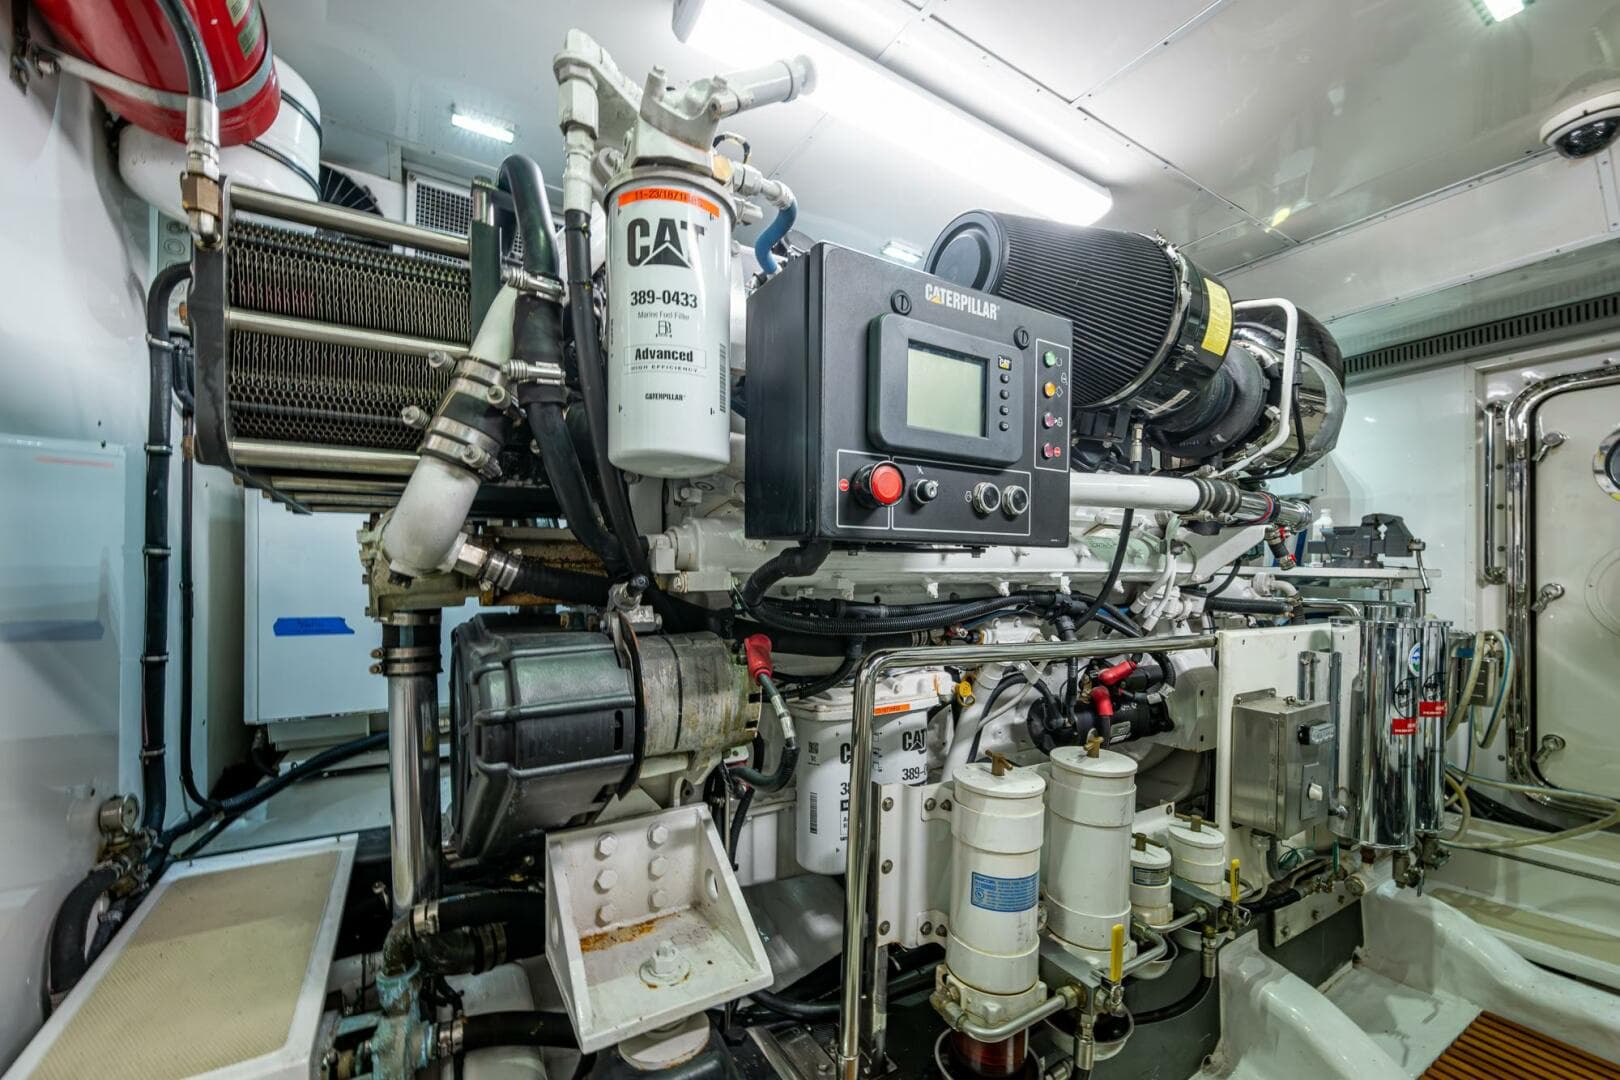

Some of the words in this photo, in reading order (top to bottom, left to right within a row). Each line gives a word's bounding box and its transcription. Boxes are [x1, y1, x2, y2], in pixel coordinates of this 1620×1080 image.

[627, 218, 704, 269] CAT
[630, 289, 697, 309] 389-0433
[925, 283, 997, 320] CATERPILLAR
[634, 347, 694, 363] Advanced
[644, 392, 683, 401] CATERPILLAR
